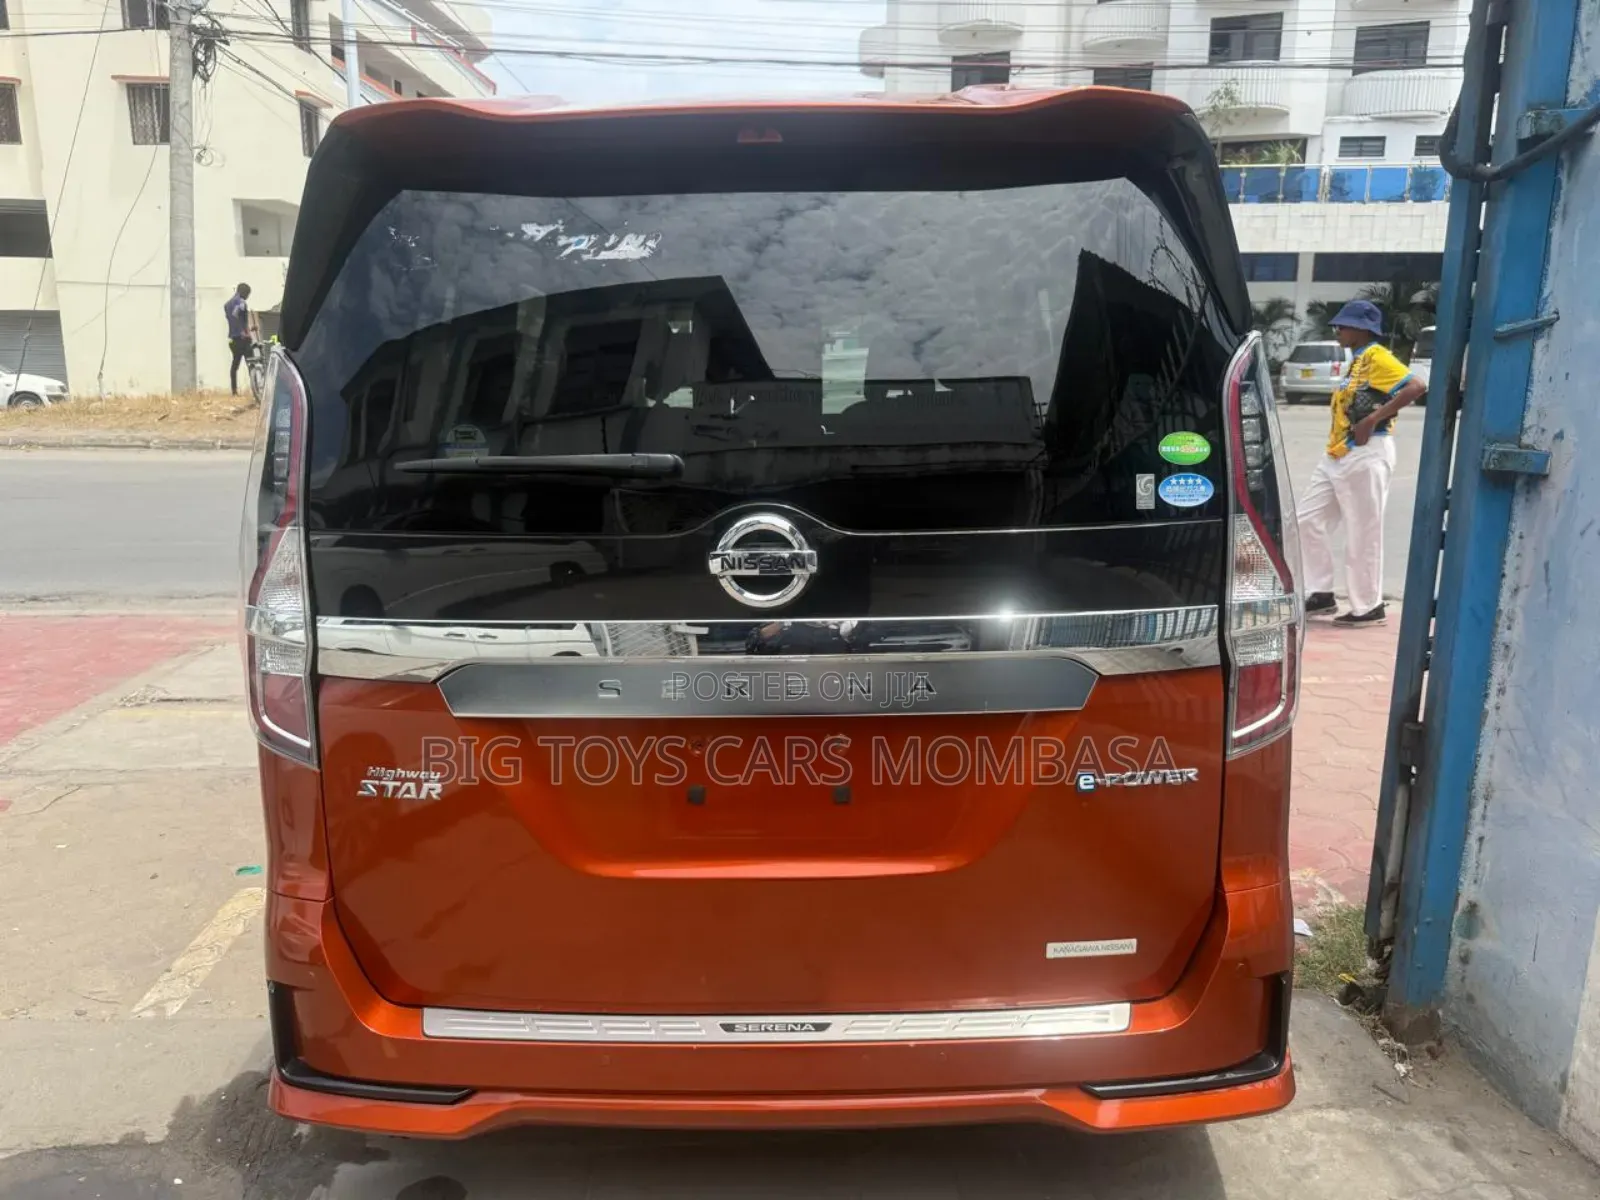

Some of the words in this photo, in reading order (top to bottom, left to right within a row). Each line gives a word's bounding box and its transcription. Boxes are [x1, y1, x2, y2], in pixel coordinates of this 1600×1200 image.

[720, 555, 806, 571] NISSAN
[598, 675, 937, 698] SERENA
[366, 766, 441, 781] Highway
[356, 780, 443, 800] STAR
[734, 1023, 816, 1032] SERENA
